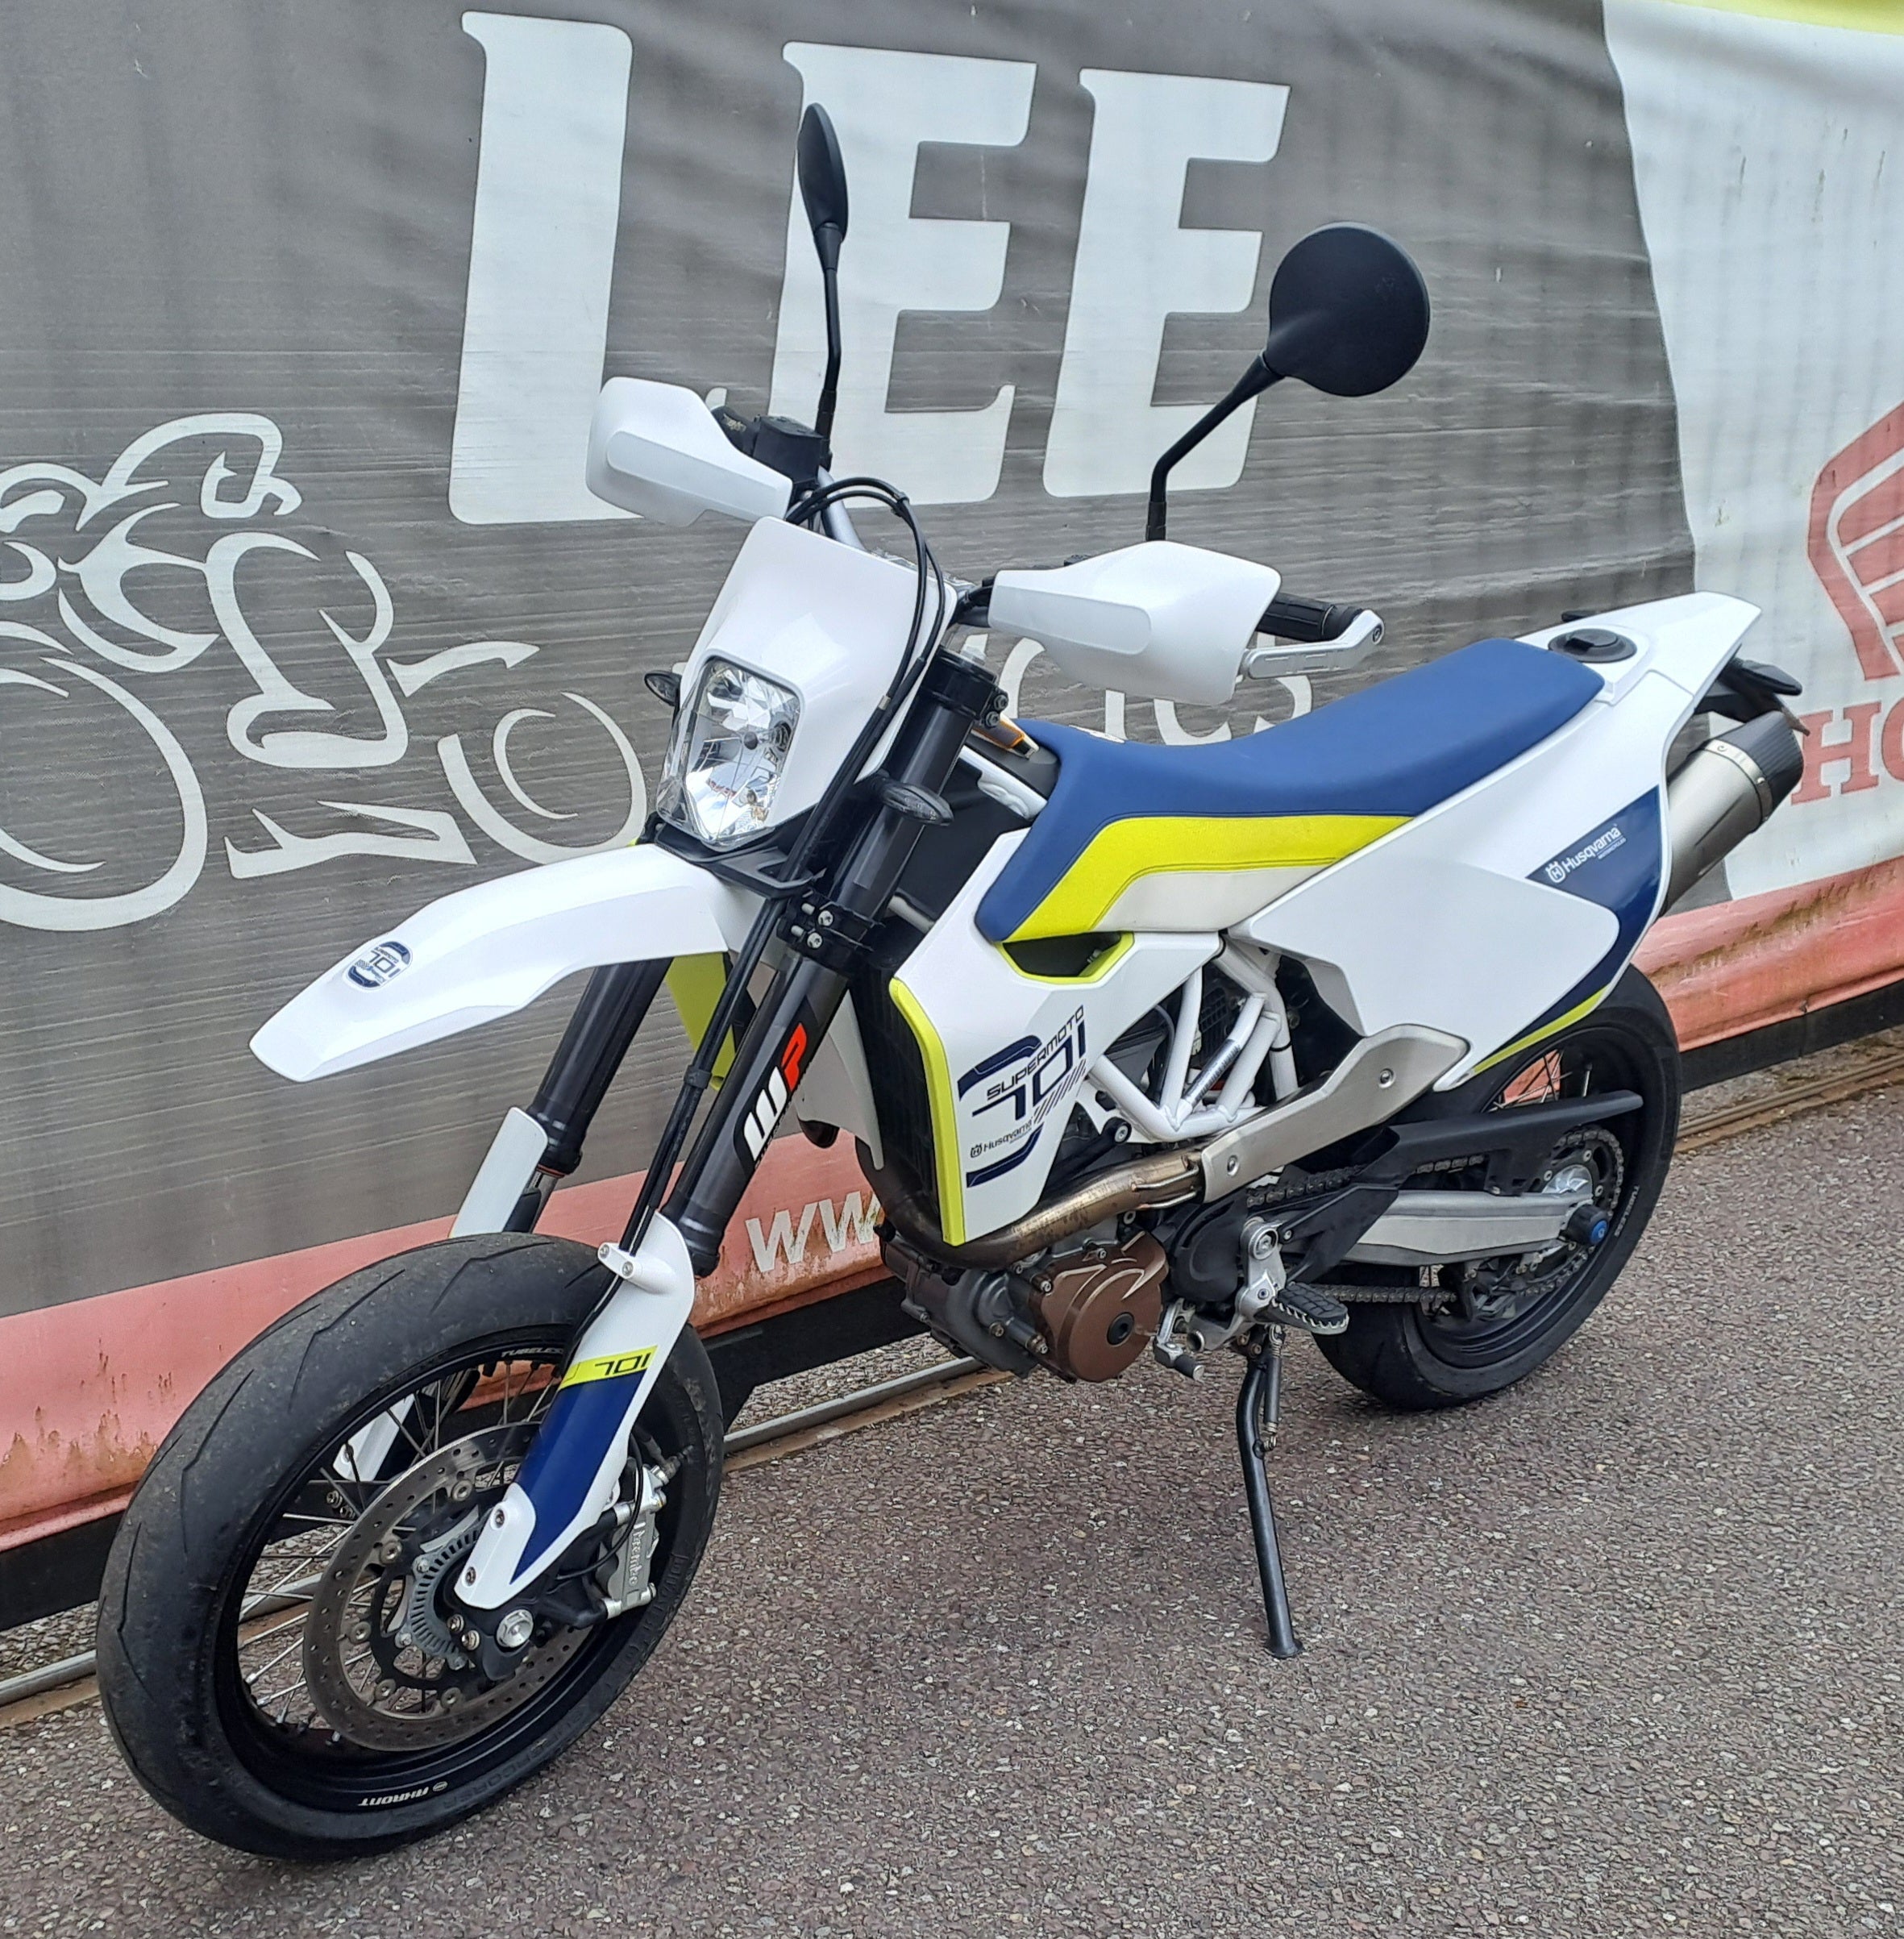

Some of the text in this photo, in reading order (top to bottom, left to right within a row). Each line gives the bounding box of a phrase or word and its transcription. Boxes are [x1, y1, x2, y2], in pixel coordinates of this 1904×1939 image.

[449, 11, 1290, 525] LEE
[1561, 826, 1622, 873] Husqvarna
[368, 950, 401, 978] 701
[971, 1019, 1087, 1121] 701
[986, 1005, 1085, 1101] SUPERMOTO
[744, 1022, 808, 1162] WP
[983, 1119, 1034, 1153] Husqvarna
[594, 1352, 651, 1376] 701
